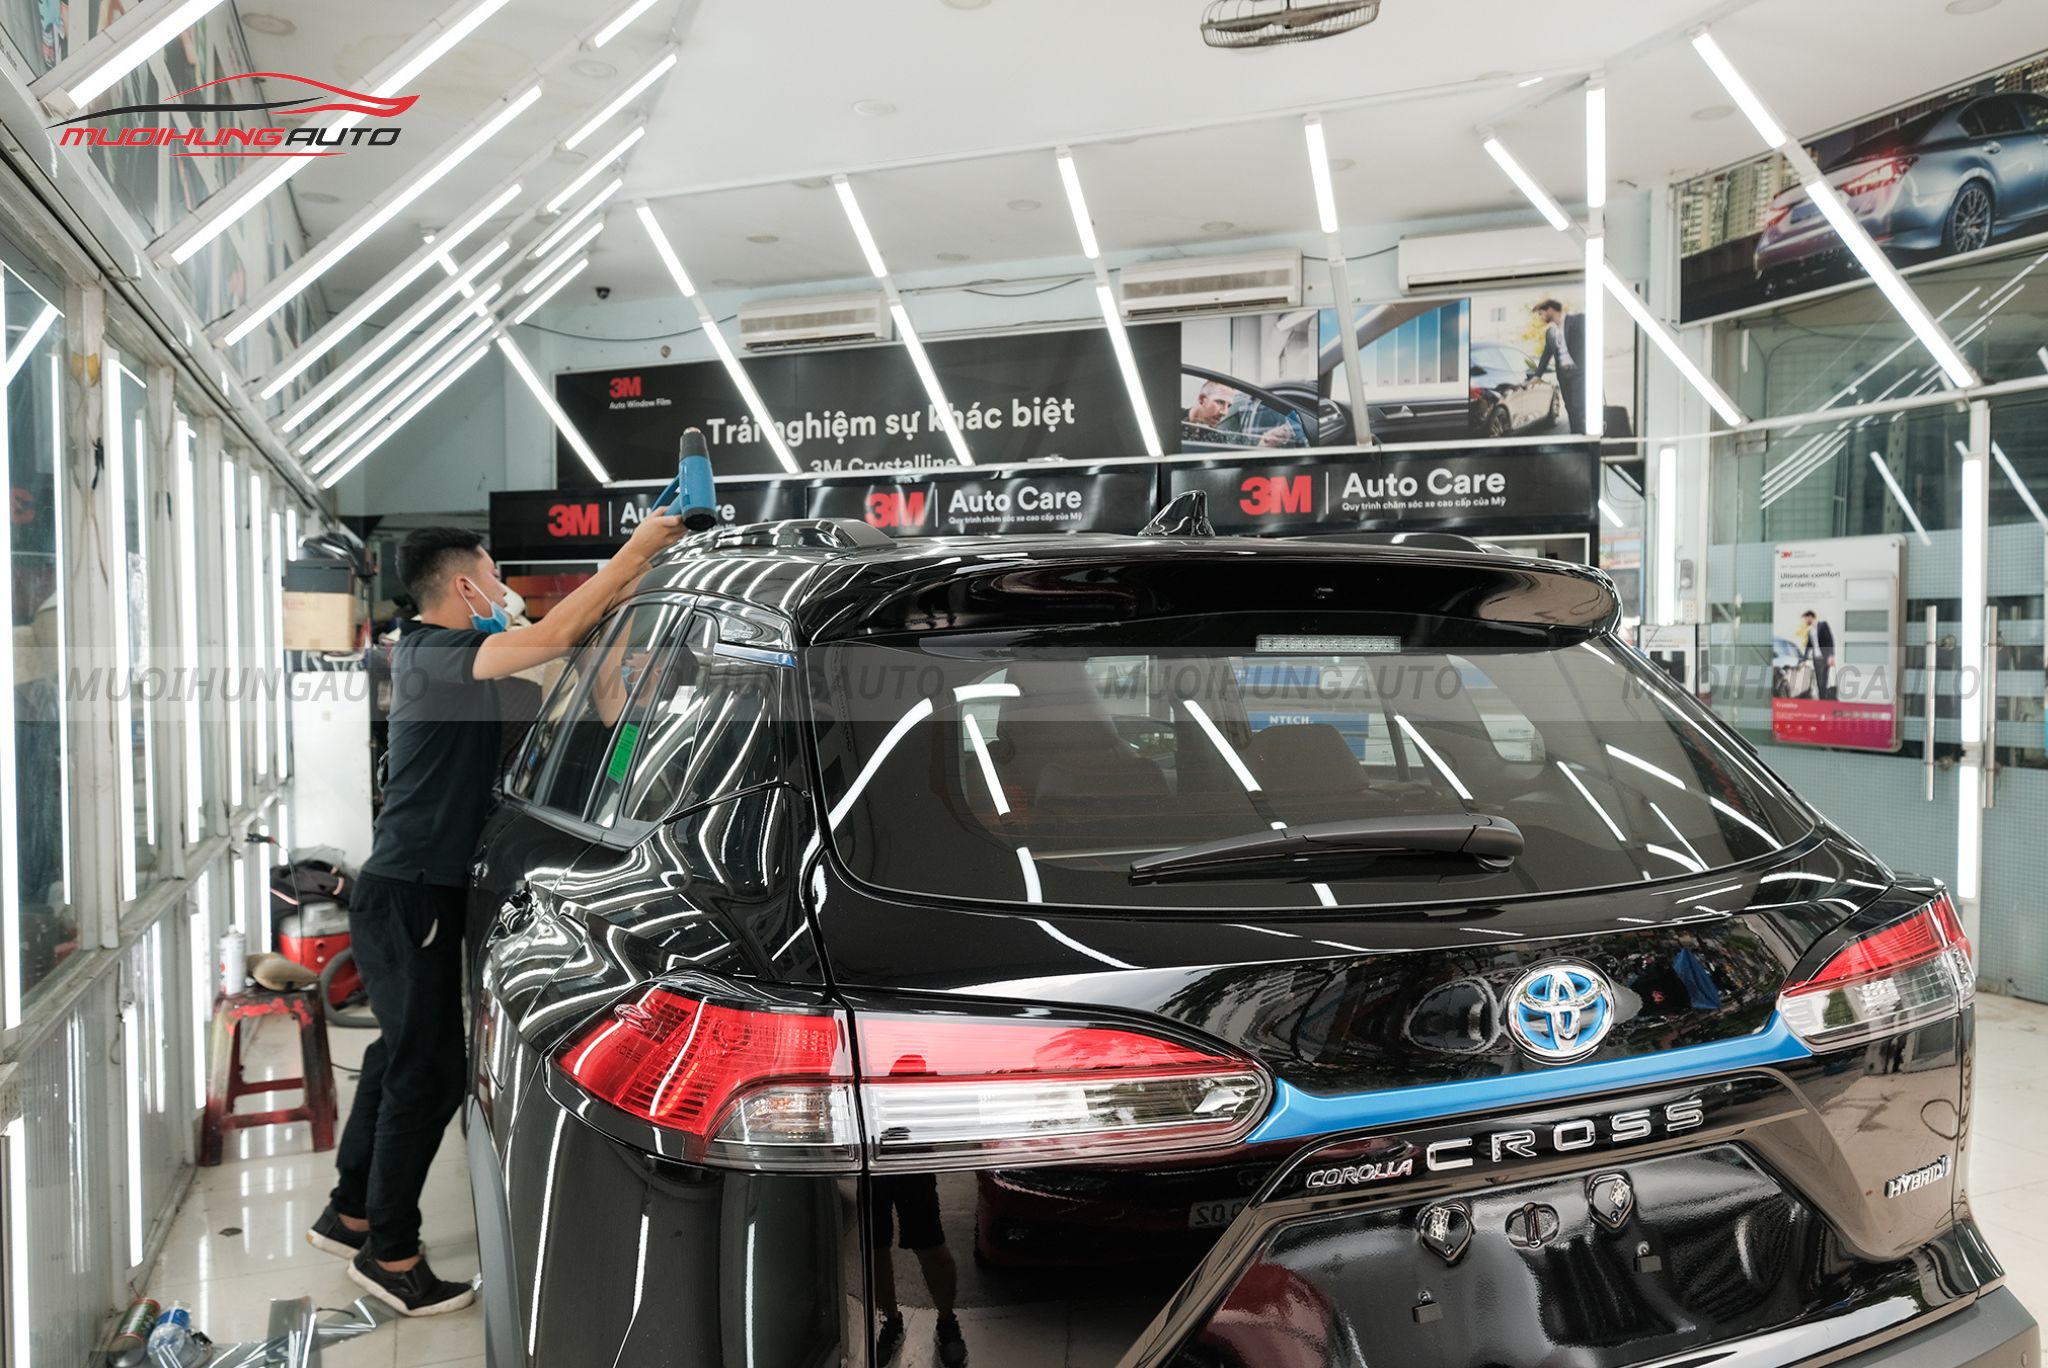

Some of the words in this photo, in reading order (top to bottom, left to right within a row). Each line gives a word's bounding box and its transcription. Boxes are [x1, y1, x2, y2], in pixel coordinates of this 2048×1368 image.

[609, 376, 641, 398] 3M
[609, 401, 626, 409] Auto
[627, 399, 655, 408] Window
[656, 397, 672, 406] Film
[1012, 396, 1075, 433] biệt
[1239, 475, 1312, 515] 3M
[1342, 472, 1418, 498] Auto
[1426, 467, 1506, 495] Care
[864, 491, 926, 528] 3M
[948, 489, 1011, 513] Auto
[1017, 486, 1082, 511] Care
[1341, 502, 1360, 512] Quy
[1425, 500, 1435, 508] xe
[1437, 499, 1453, 508] cao
[547, 502, 600, 537] 3M
[1780, 572, 1809, 580] Ultimate
[1306, 1158, 1414, 1189] COROLLA
[1426, 1099, 1704, 1171] CROSS
[1884, 1163, 1944, 1199] HYBRID
